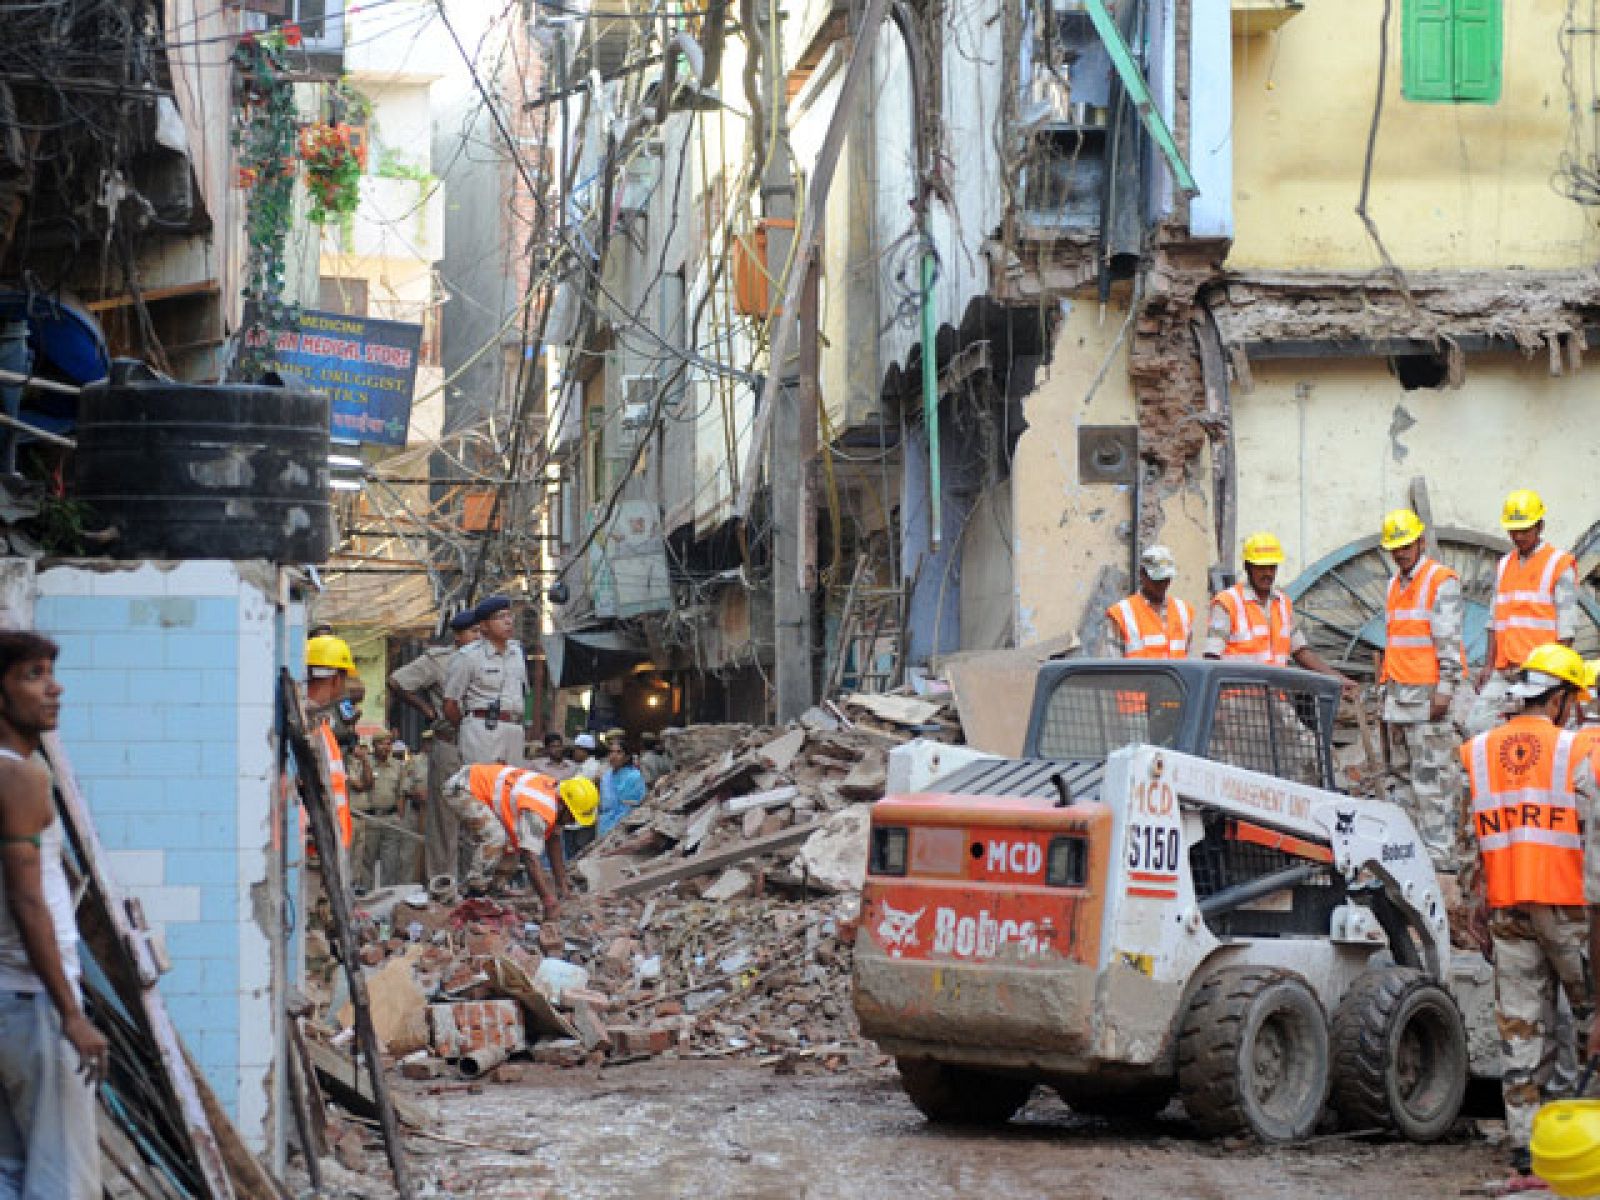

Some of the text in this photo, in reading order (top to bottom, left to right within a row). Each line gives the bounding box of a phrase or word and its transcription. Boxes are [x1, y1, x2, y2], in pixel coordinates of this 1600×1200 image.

[299, 315, 365, 334] MEDICINE
[301, 335, 361, 361] MEDICAL
[365, 343, 411, 368] STORE
[987, 840, 1042, 874] MCD
[1129, 824, 1180, 871] S150
